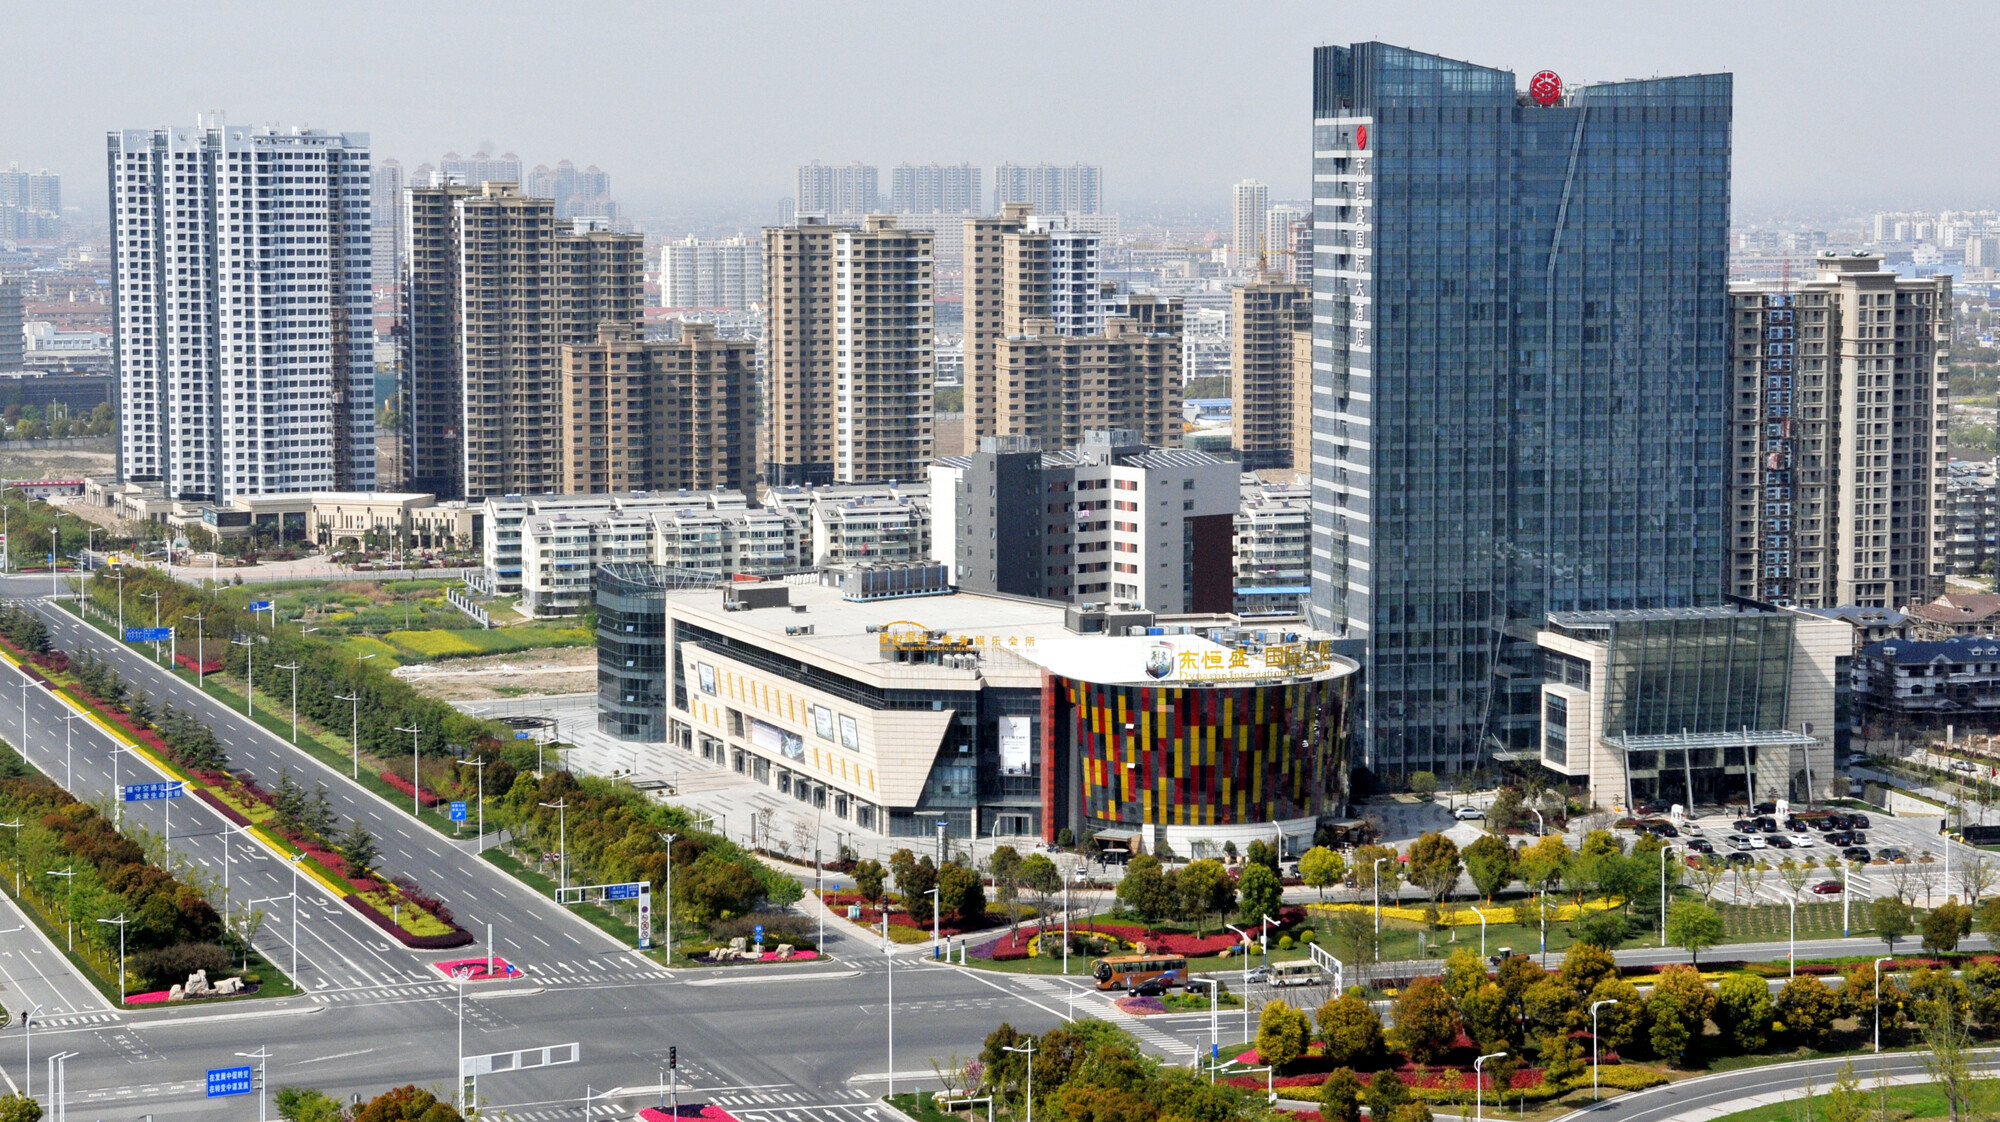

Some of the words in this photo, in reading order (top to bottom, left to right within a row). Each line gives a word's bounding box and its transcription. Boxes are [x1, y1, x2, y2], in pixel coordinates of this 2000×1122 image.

[1355, 156, 1366, 347] 东恒盛国际大酒店
[1179, 671, 1227, 683] Dynasun
